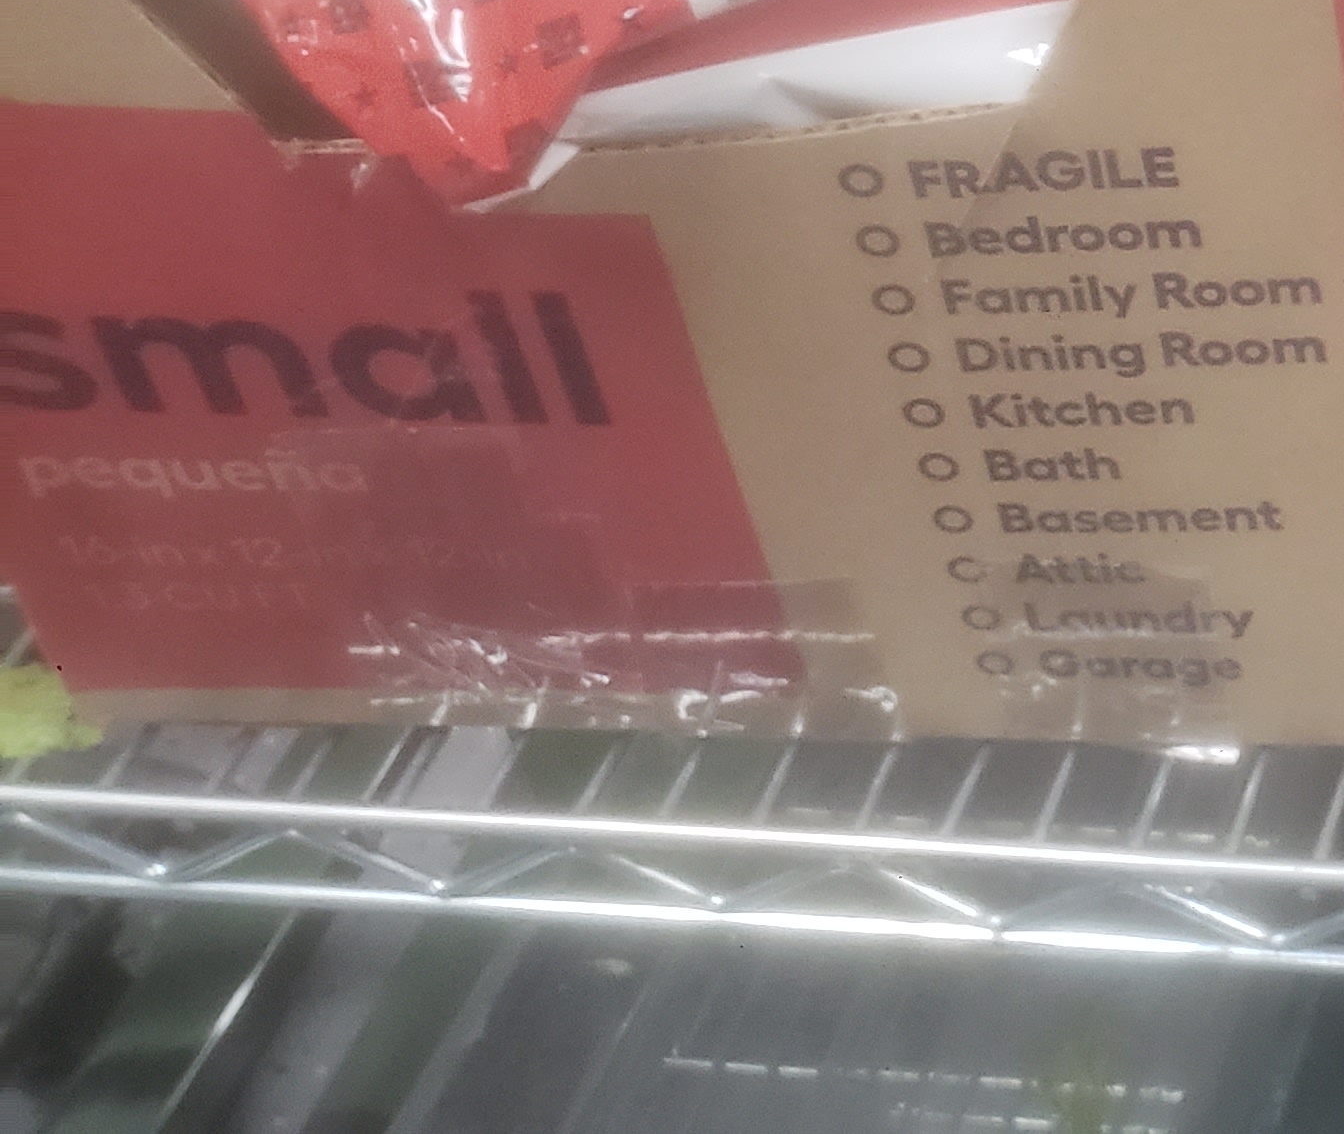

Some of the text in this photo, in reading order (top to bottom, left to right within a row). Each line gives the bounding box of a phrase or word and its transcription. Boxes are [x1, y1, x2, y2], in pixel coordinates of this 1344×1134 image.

[908, 146, 1181, 199] FRAGILE
[925, 216, 1202, 259] Bedroom
[940, 271, 1323, 318] Family Room
[0, 290, 612, 426] small
[954, 331, 1329, 378] Dining Room
[969, 392, 1196, 429] Kitchen
[16, 448, 368, 498] pequeña
[982, 447, 1122, 482] Bath
[997, 500, 1284, 534] Basement
[1013, 552, 1146, 586] Attic
[1025, 604, 1254, 639] Laundry
[1039, 647, 1244, 687] Garage
